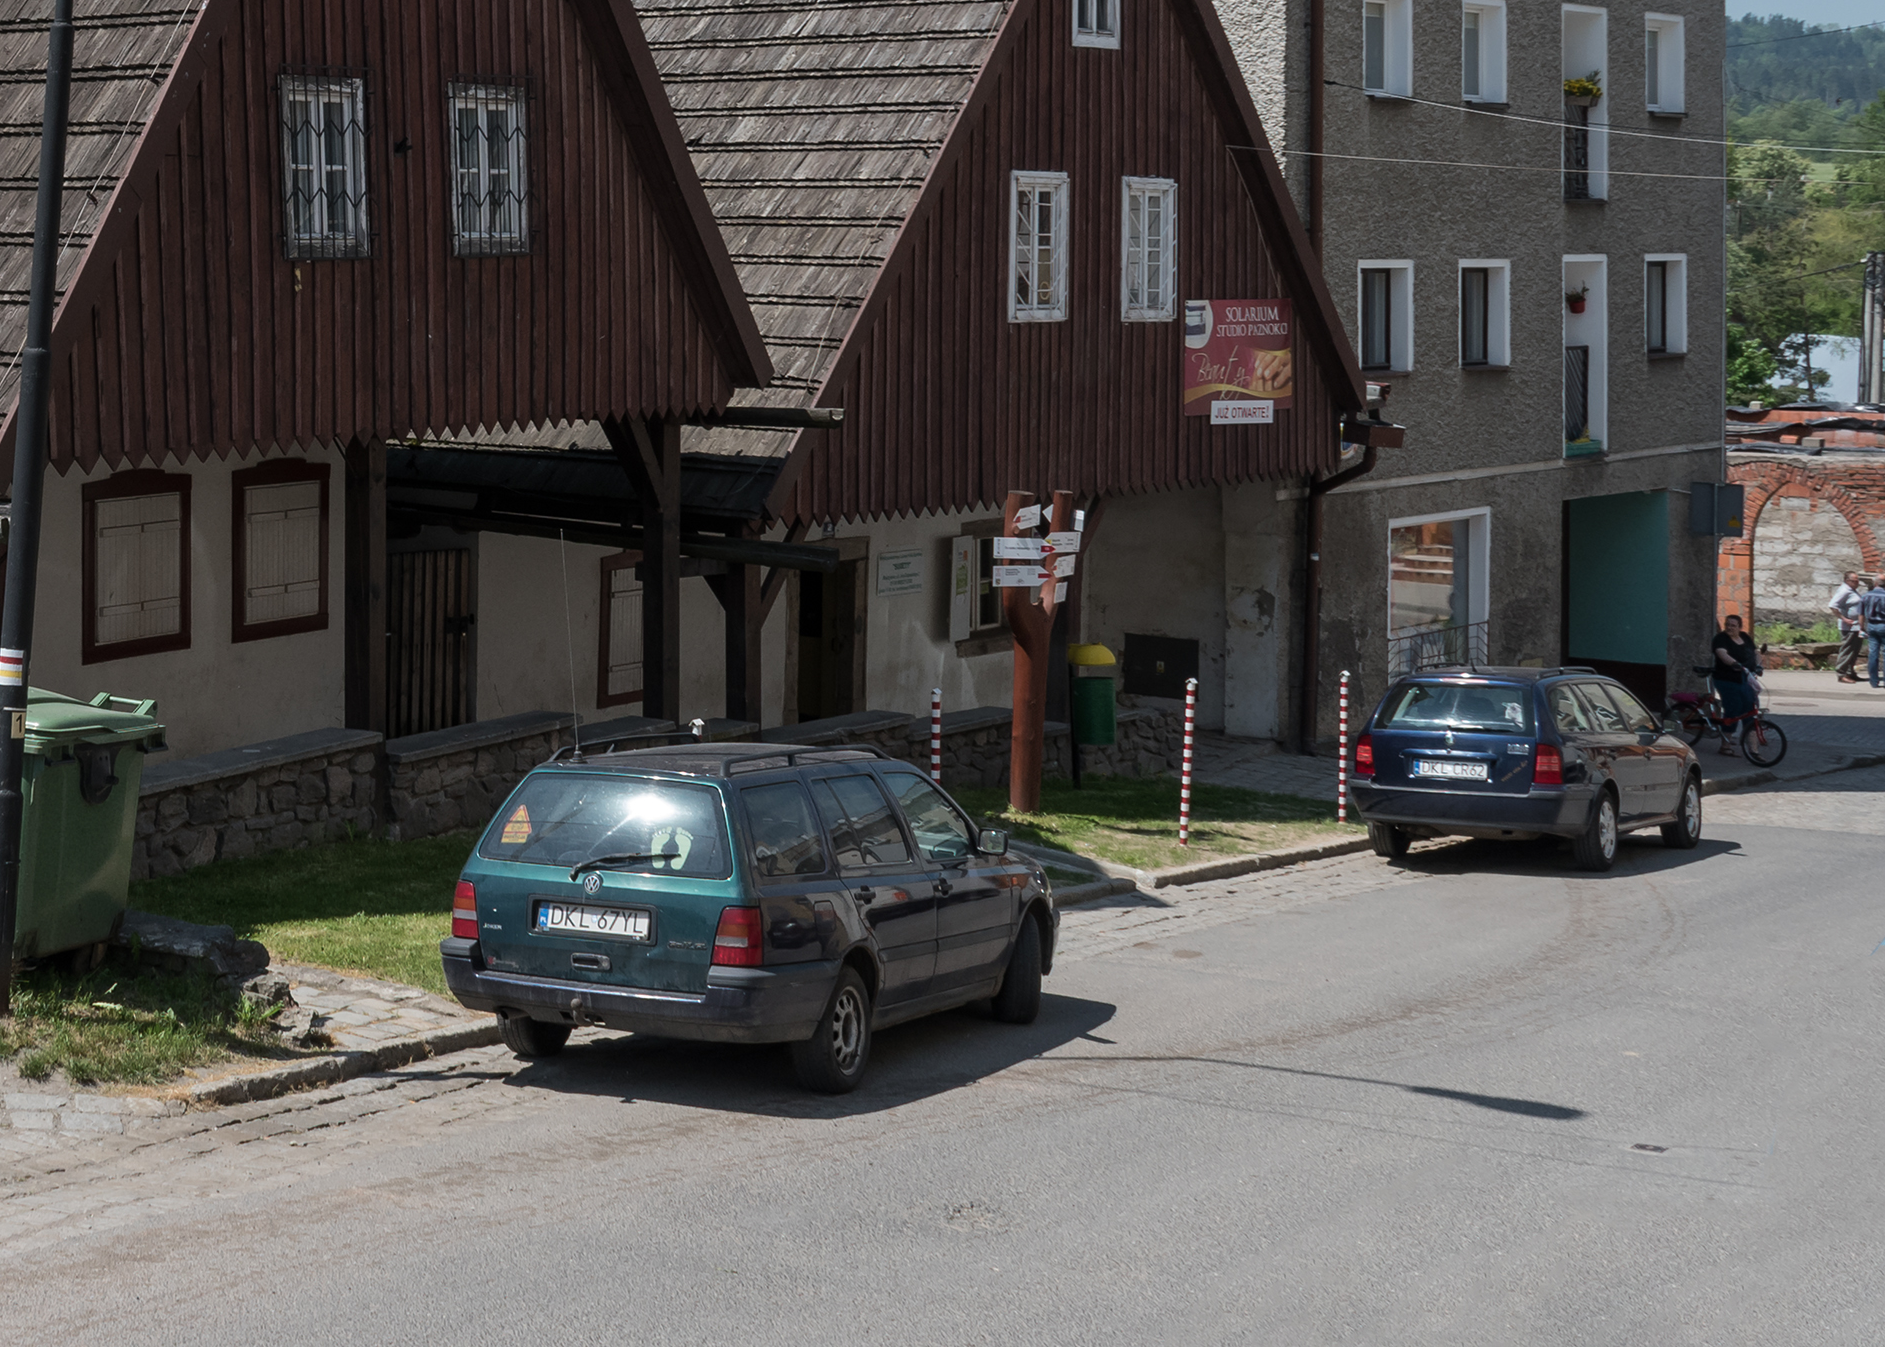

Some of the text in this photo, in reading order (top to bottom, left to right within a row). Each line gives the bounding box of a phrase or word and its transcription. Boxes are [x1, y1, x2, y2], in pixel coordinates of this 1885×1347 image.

[1225, 306, 1280, 322] SOLARIUM
[1216, 324, 1247, 337] STUDIO
[1215, 405, 1270, 419] JUŻ OTWARTE!
[1422, 760, 1448, 774] DKL
[1453, 762, 1485, 777] CR62
[551, 905, 590, 929] DKL
[597, 909, 643, 934] 67YL
